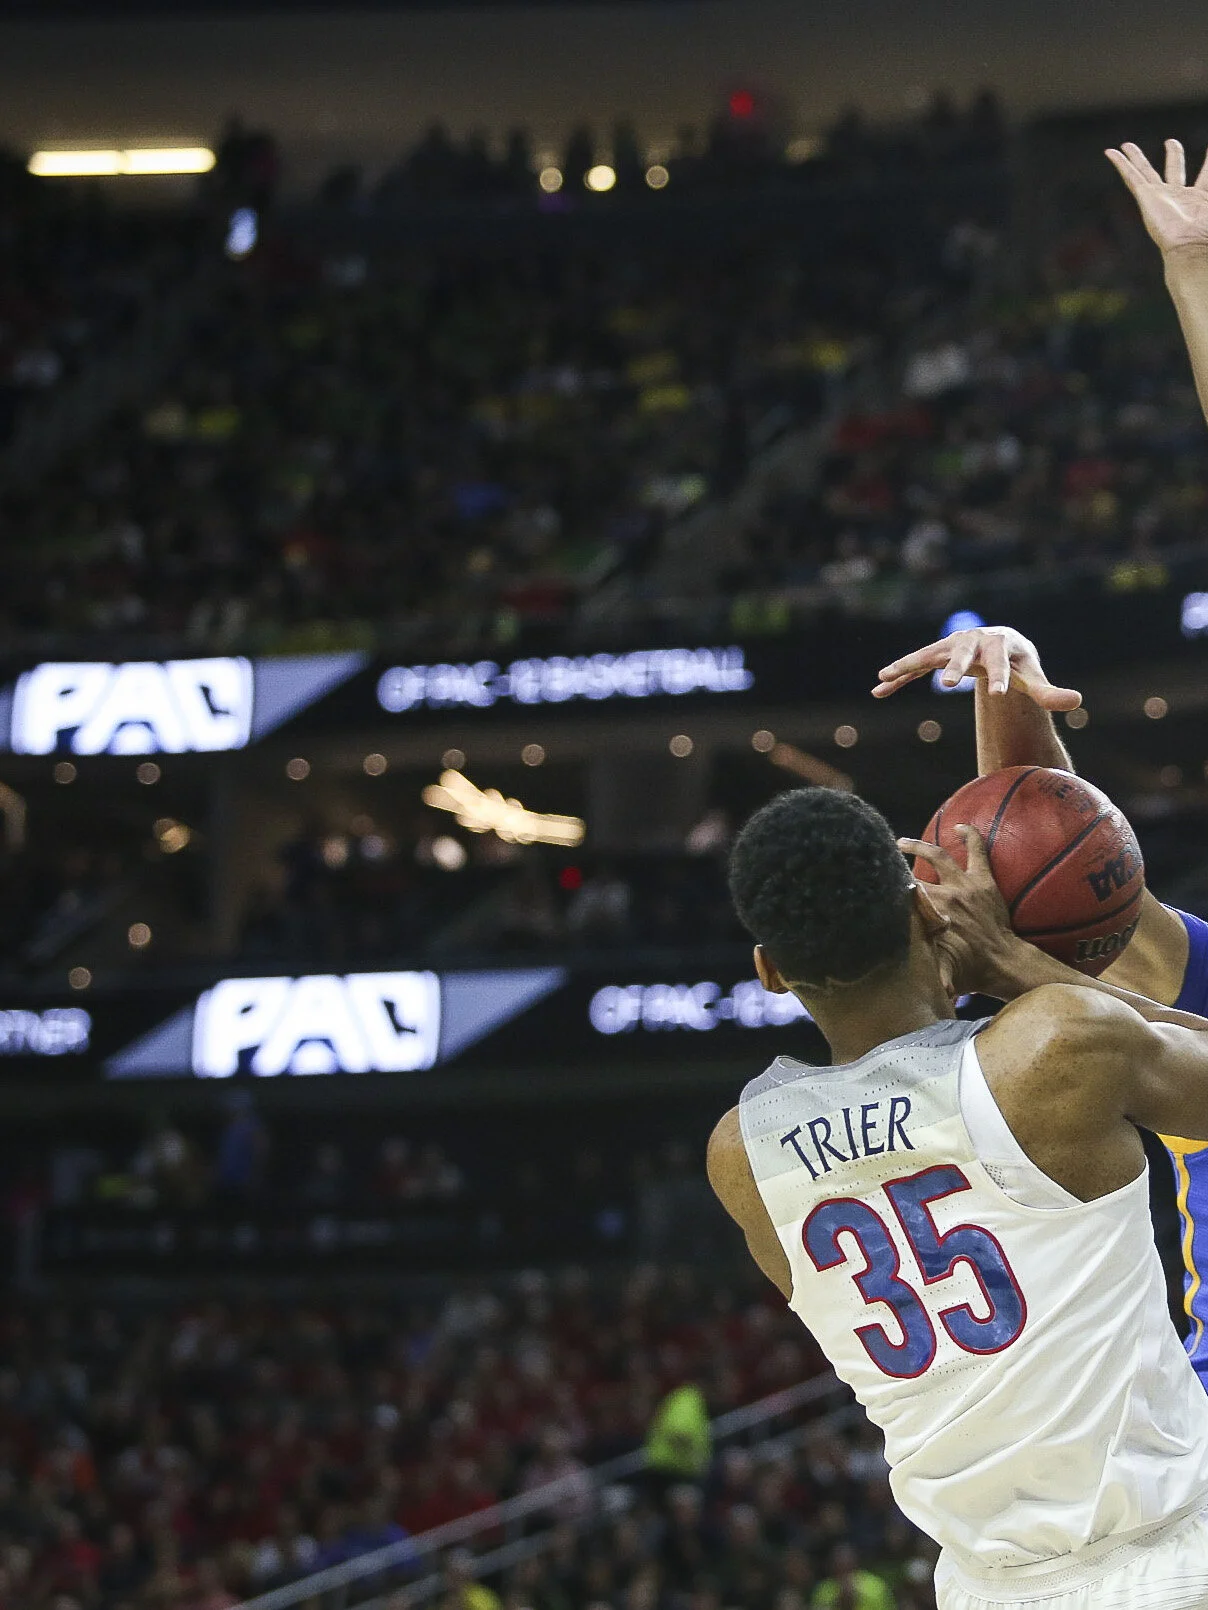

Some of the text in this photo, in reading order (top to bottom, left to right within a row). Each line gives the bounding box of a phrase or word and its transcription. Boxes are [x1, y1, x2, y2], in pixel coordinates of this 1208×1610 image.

[192, 970, 440, 1078] PAC
[780, 1096, 915, 1181] TRIER
[802, 1164, 1027, 1379] 35
